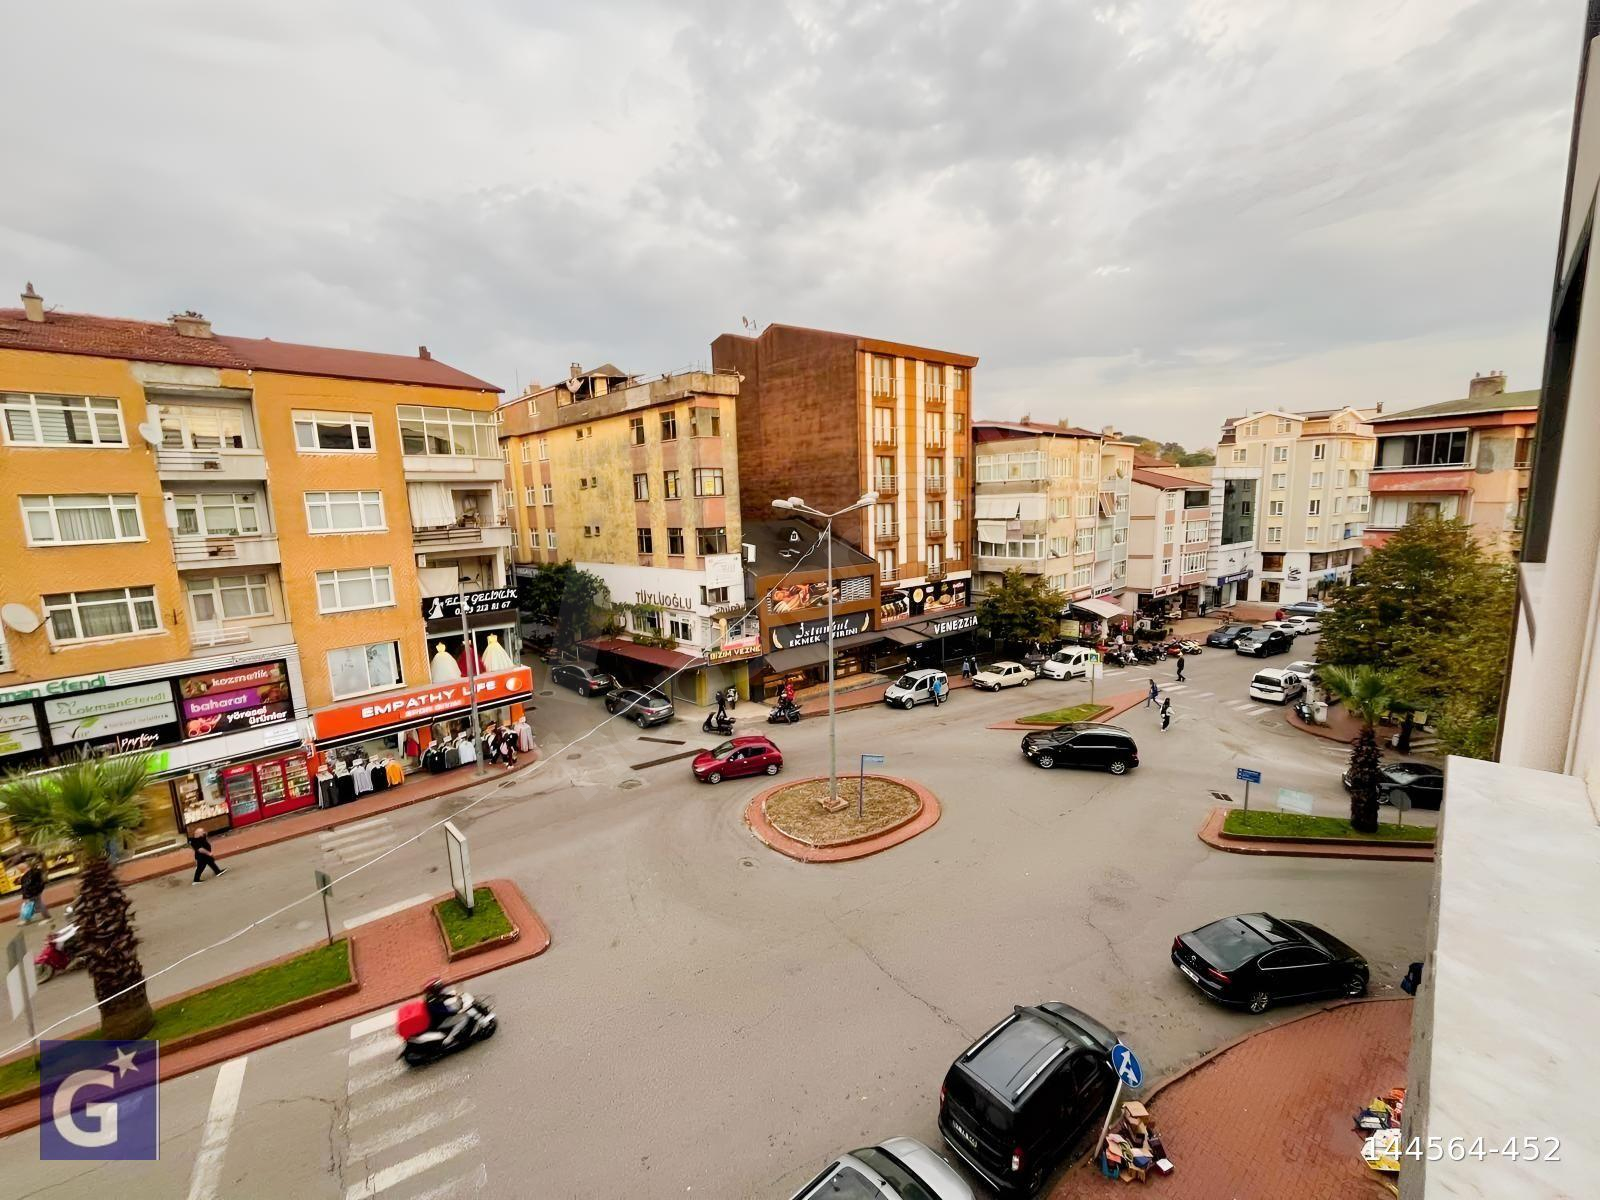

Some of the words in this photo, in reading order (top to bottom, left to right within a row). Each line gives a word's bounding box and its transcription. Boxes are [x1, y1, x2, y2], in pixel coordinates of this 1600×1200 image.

[789, 635, 821, 647] EKMEK
[190, 695, 248, 713] baharat
[361, 688, 455, 719] EMPATHY
